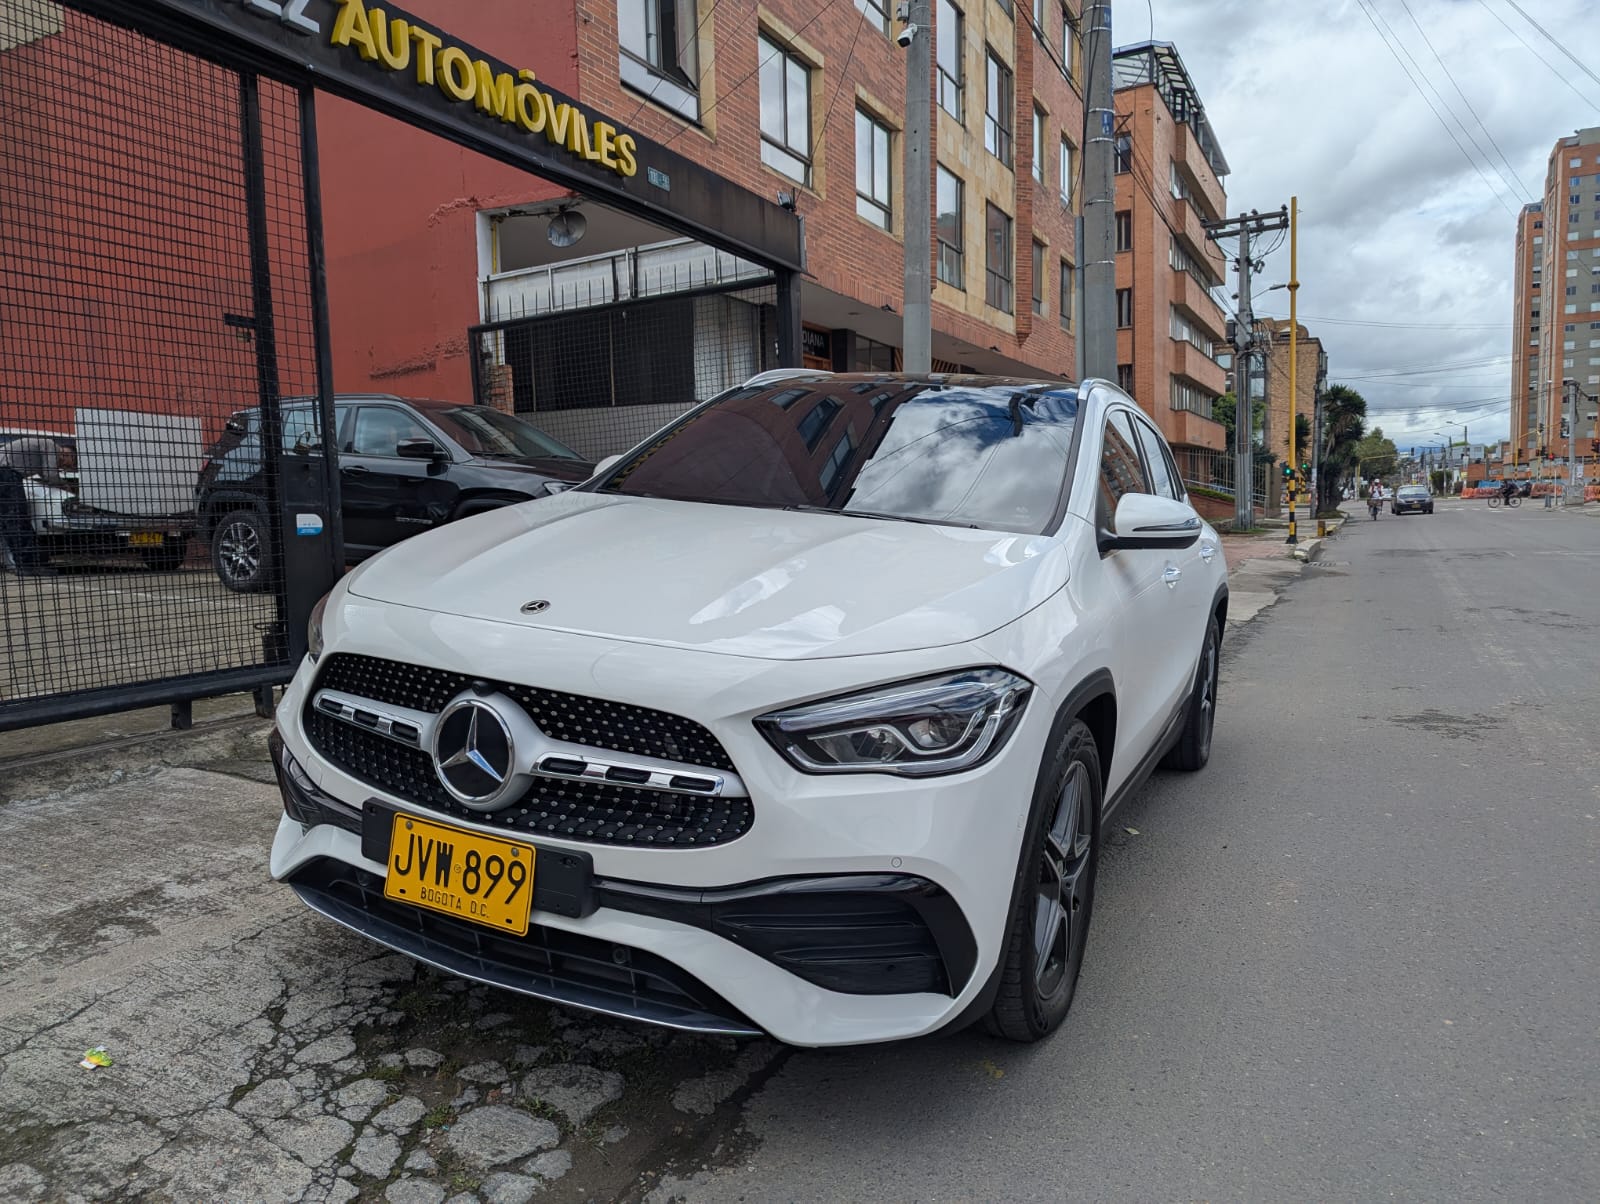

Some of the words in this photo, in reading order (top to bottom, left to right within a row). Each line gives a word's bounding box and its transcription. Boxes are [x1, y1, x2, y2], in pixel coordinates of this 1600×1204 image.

[330, 0, 638, 178] AUTOMÓVILES
[395, 833, 454, 888] JVW
[462, 849, 527, 905] 899
[420, 886, 462, 910] BOGOTA
